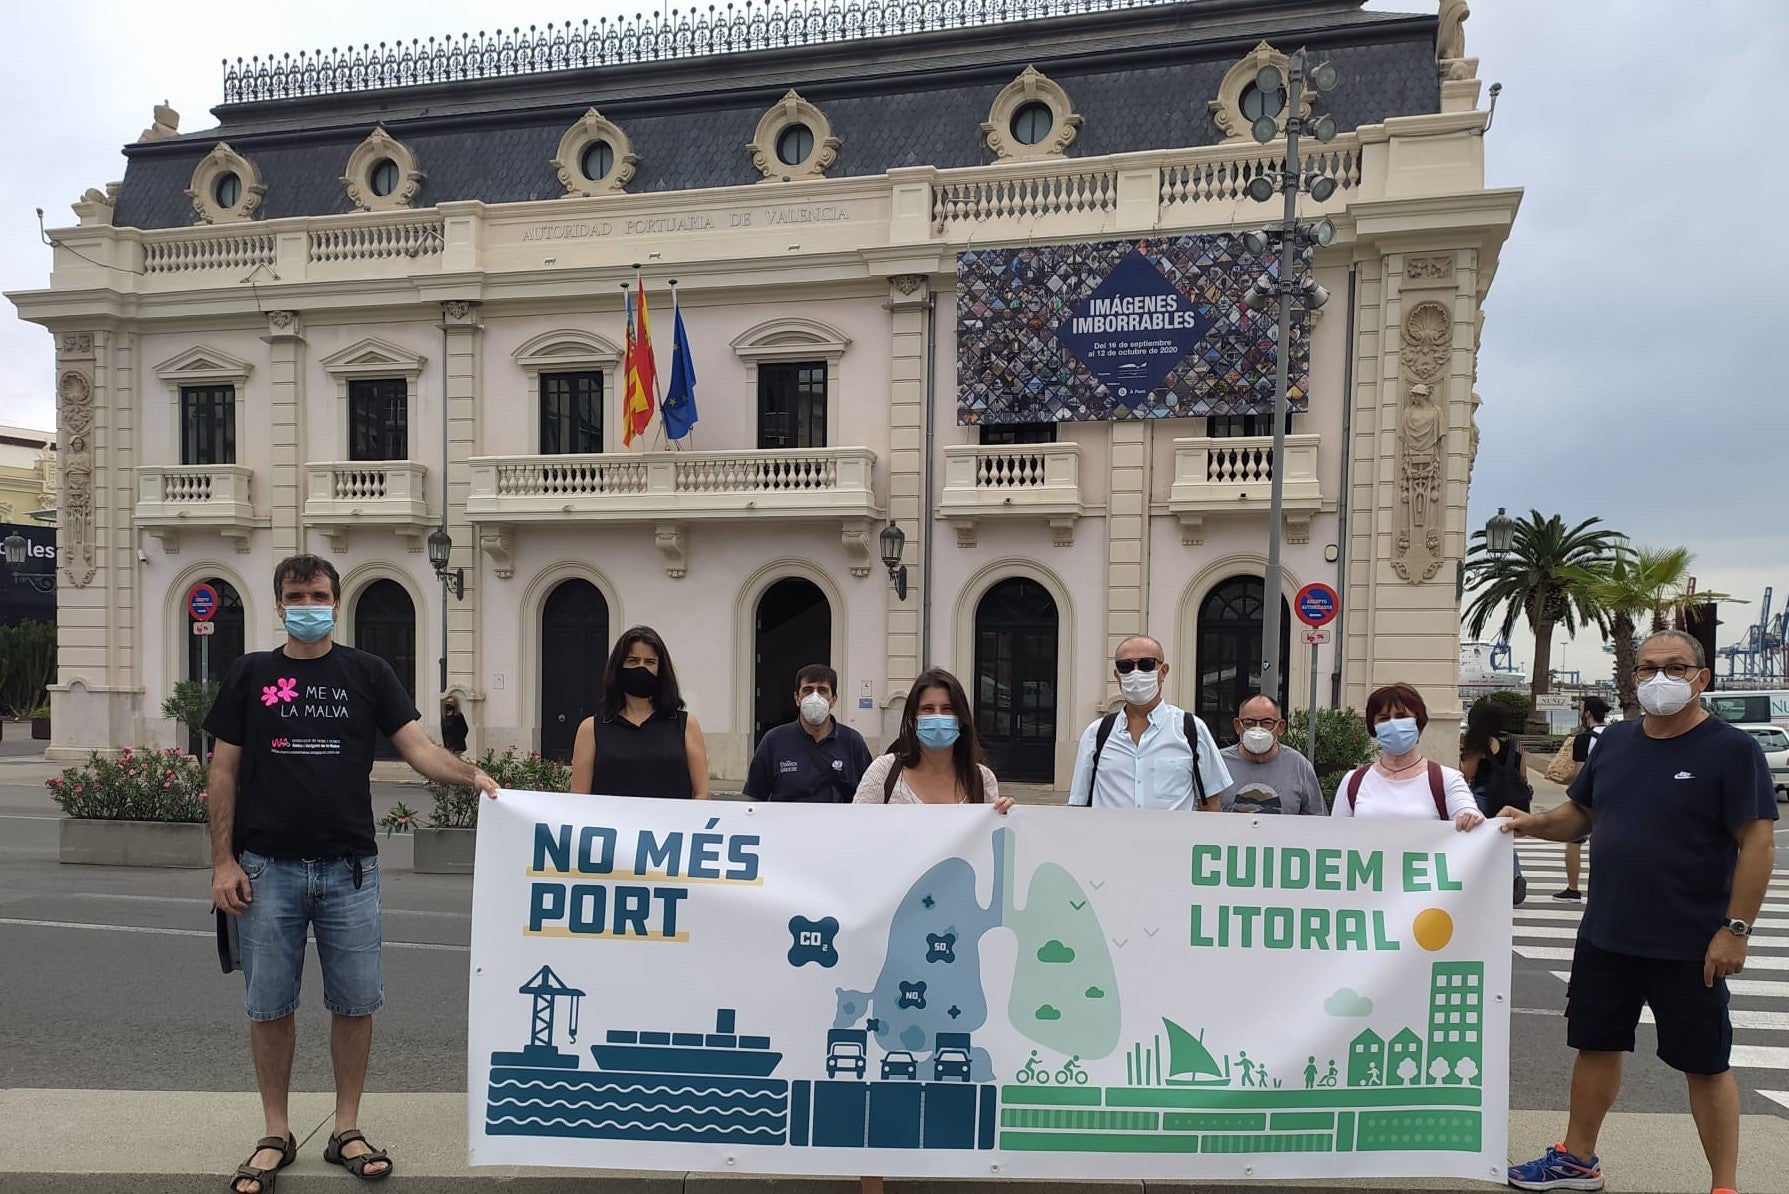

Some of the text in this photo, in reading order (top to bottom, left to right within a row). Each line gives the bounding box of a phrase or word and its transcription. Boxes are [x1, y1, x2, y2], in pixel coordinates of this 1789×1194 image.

[522, 206, 848, 242] AUTORIDAD PORTUARIA DE VALENCIA
[1089, 294, 1178, 316] IMÁGENES
[1072, 311, 1195, 334] IMBORRABLES
[1094, 342, 1107, 350] Del
[1129, 340, 1172, 350] septiembre
[1097, 349, 1105, 357] 12
[1118, 347, 1147, 356] octubre
[1159, 346, 1178, 354] 2020
[305, 686, 349, 701] ME VA
[281, 704, 349, 719] LA MALVA
[532, 817, 761, 881] NO MÉS
[1191, 844, 1463, 893] CUIDEM EL
[529, 882, 689, 938] PORT
[1190, 904, 1400, 951] LITORAL
